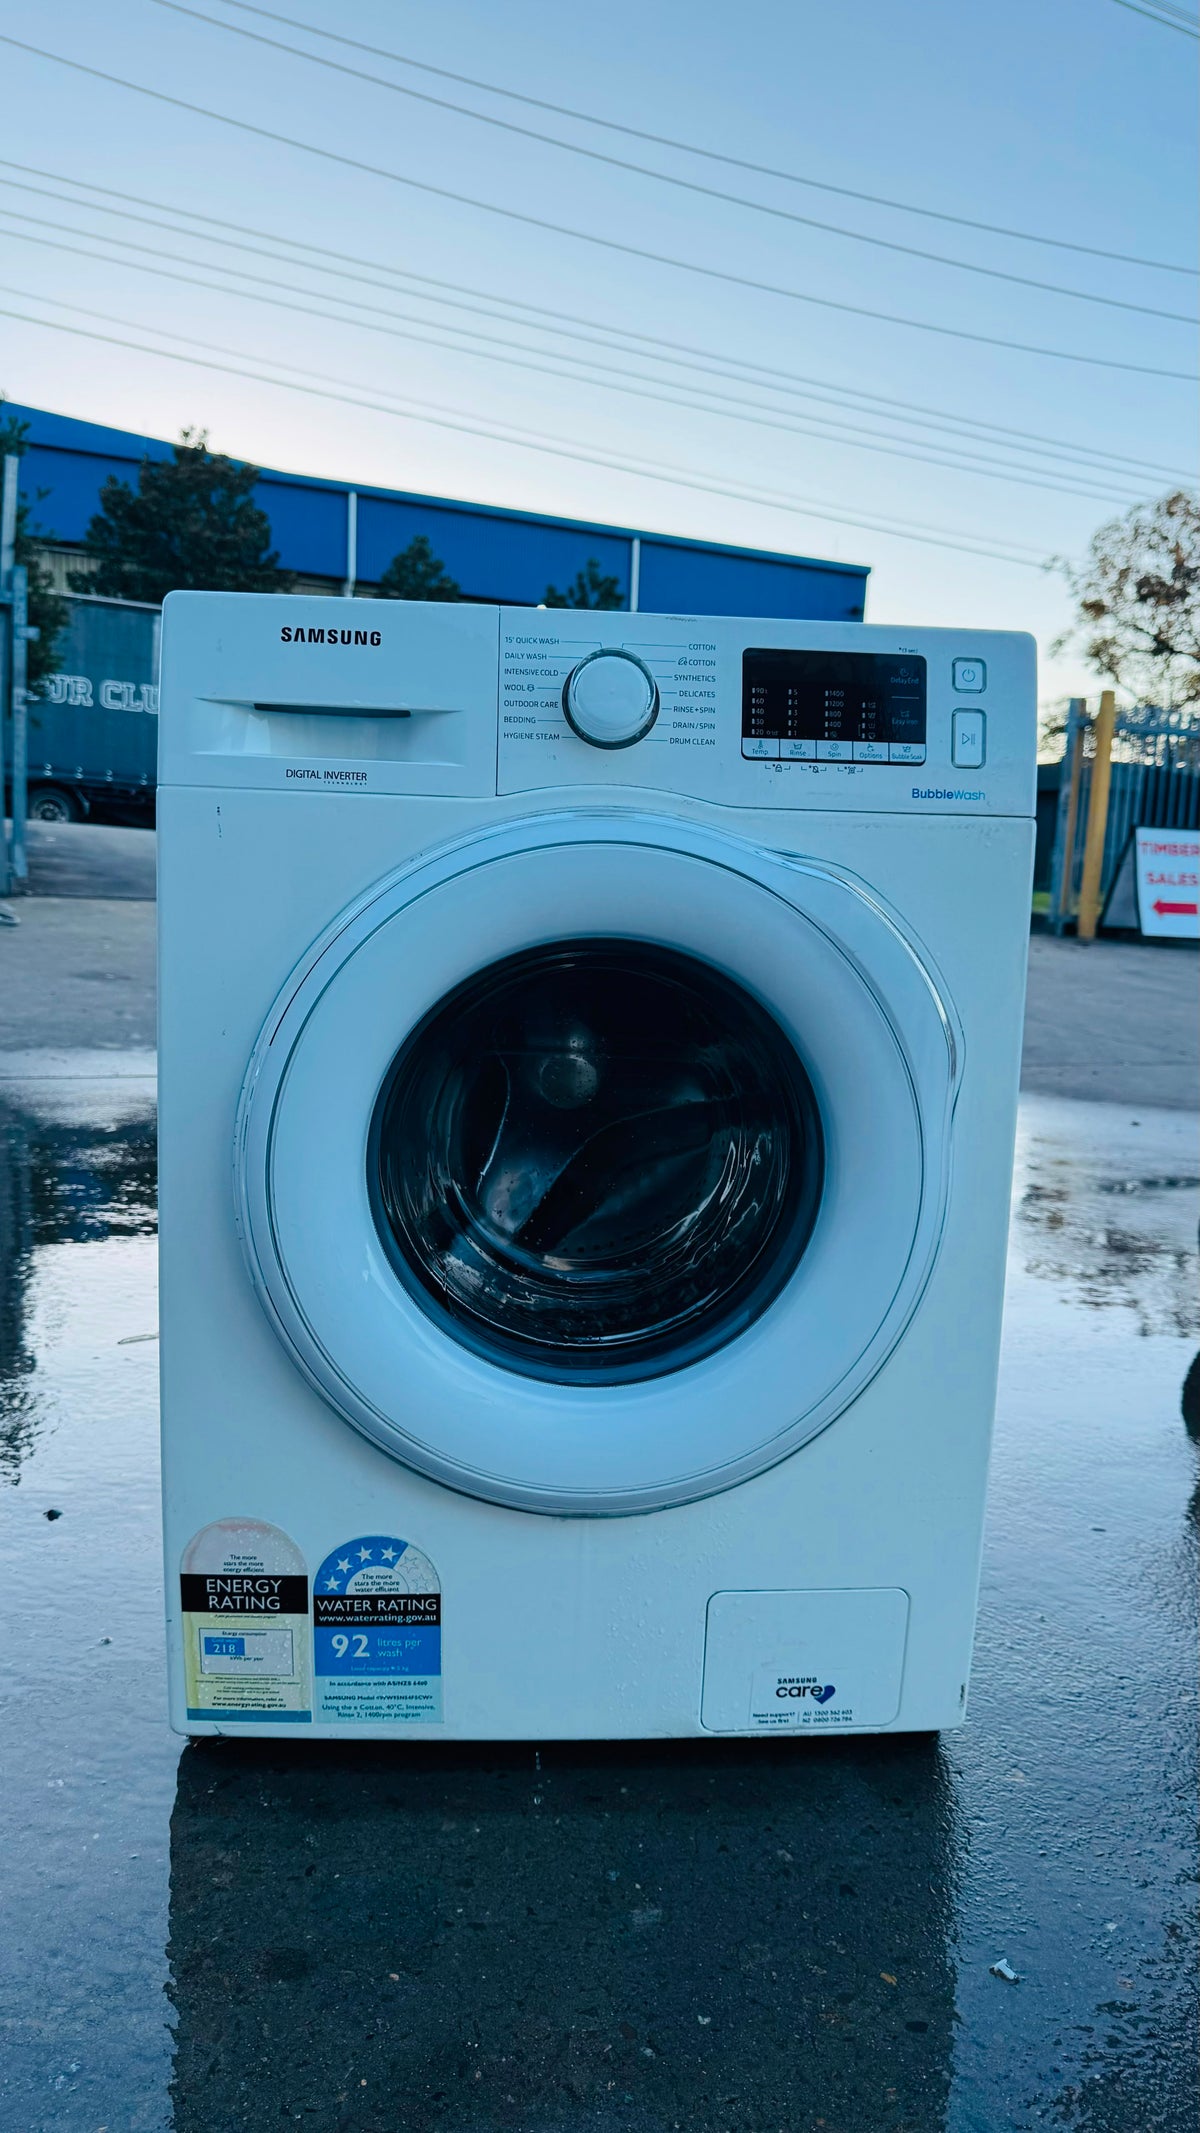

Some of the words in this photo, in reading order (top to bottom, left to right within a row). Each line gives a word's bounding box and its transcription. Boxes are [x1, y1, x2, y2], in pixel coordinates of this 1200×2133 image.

[280, 627, 382, 646] SAMSUNG
[505, 636, 515, 644] 15'
[515, 637, 538, 645] QUICK
[688, 643, 716, 651] COTTON
[504, 652, 525, 660] DAILY
[688, 659, 716, 667] COTTON
[504, 668, 540, 676] INTENSIVE
[540, 669, 559, 677] COLD
[673, 674, 716, 683] SYNTHETICS
[504, 684, 526, 692] WOOL
[679, 690, 716, 698] DELICATES
[504, 700, 539, 708] OUTDOOR
[540, 701, 559, 709] CARE
[829, 700, 844, 708] 1200
[503, 716, 537, 724] BEDDING
[503, 732, 535, 740] HYGIENE
[535, 733, 560, 741] STEAM
[669, 737, 690, 745] DRUM
[692, 738, 716, 746] CLEAN
[752, 748, 769, 756] Temp
[828, 750, 842, 758] Spin
[860, 751, 883, 760] Options
[892, 752, 910, 760] Bubble
[285, 768, 322, 780] DIGITAL
[323, 770, 368, 781] INVERTER
[912, 788, 986, 801] BubbleWash
[1139, 842, 1200, 856] TIMBER
[1146, 872, 1198, 886] SALES
[206, 1579, 282, 1593] ENERGY
[209, 1595, 281, 1610] RATING
[317, 1599, 372, 1611] WATER
[377, 1598, 437, 1611] RATING
[319, 1613, 437, 1623] www.waterrating.gov.au
[213, 1643, 236, 1653] 218
[331, 1633, 370, 1658] 92
[377, 1638, 402, 1647] litres
[405, 1638, 422, 1649] per
[377, 1648, 403, 1657] wash
[777, 1677, 817, 1685] SAMSUNG
[776, 1685, 823, 1698] care
